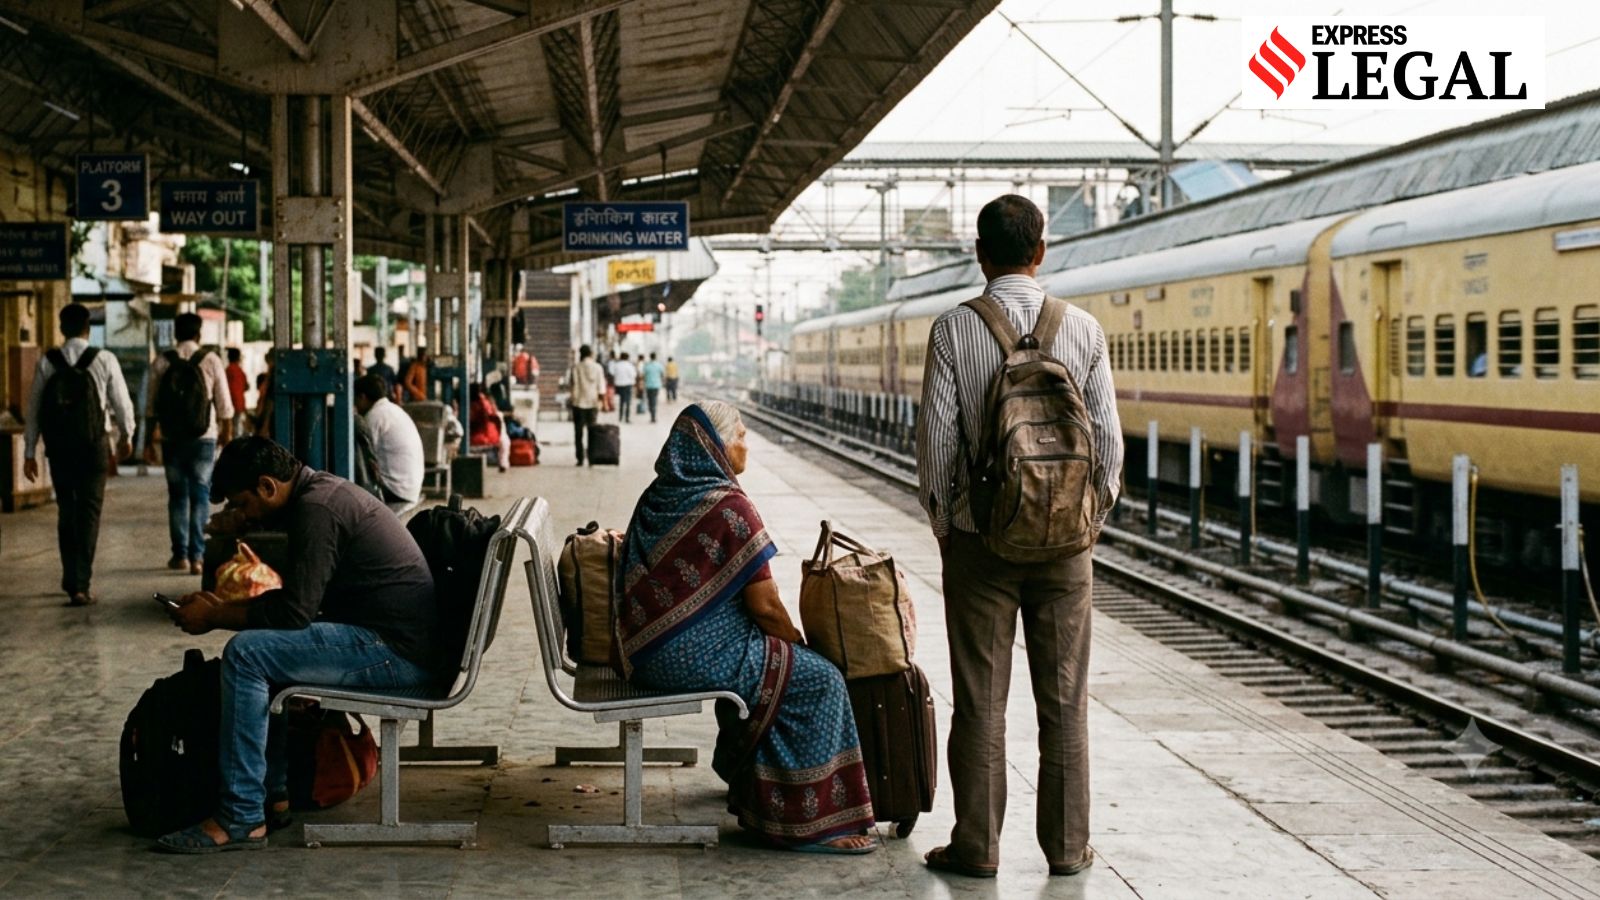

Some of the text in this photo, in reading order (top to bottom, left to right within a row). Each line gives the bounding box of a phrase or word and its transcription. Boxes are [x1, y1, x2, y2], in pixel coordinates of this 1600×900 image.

[81, 159, 142, 174] PLATFORM
[100, 179, 123, 212] 3
[170, 210, 247, 225] WAY OUT
[569, 230, 683, 246] DRINKING WATER
